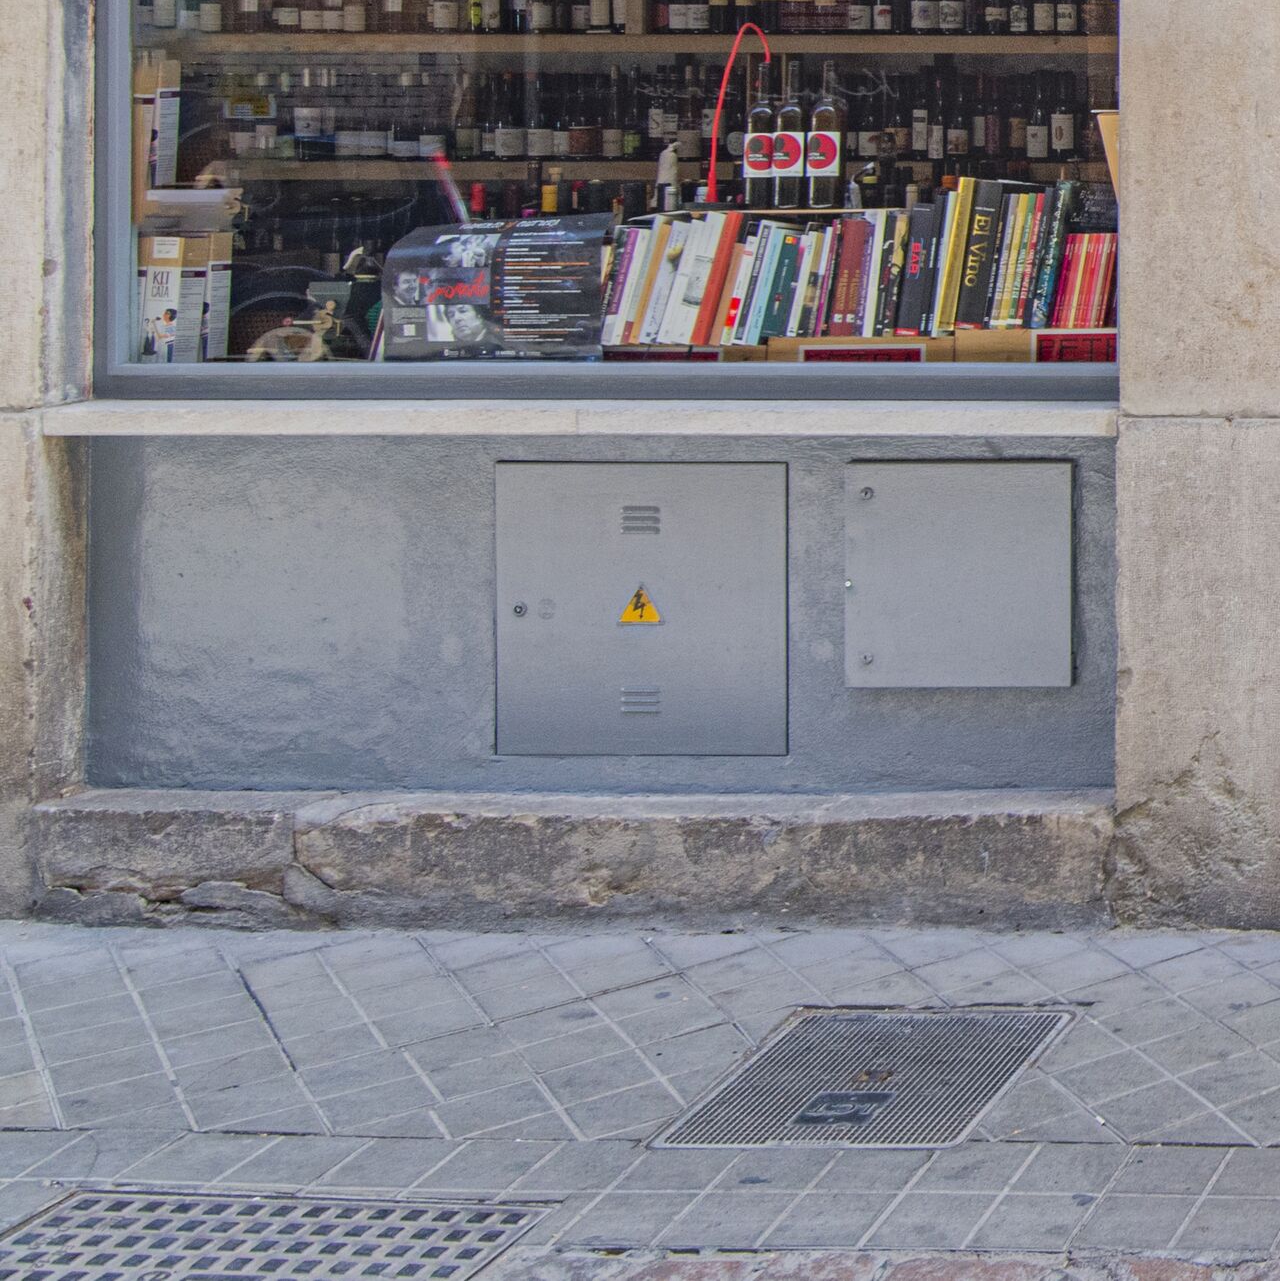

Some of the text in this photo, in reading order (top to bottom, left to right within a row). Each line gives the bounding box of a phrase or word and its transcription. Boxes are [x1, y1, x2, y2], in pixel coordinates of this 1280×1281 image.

[964, 212, 993, 287] El Vino
[152, 270, 171, 286] KIT
